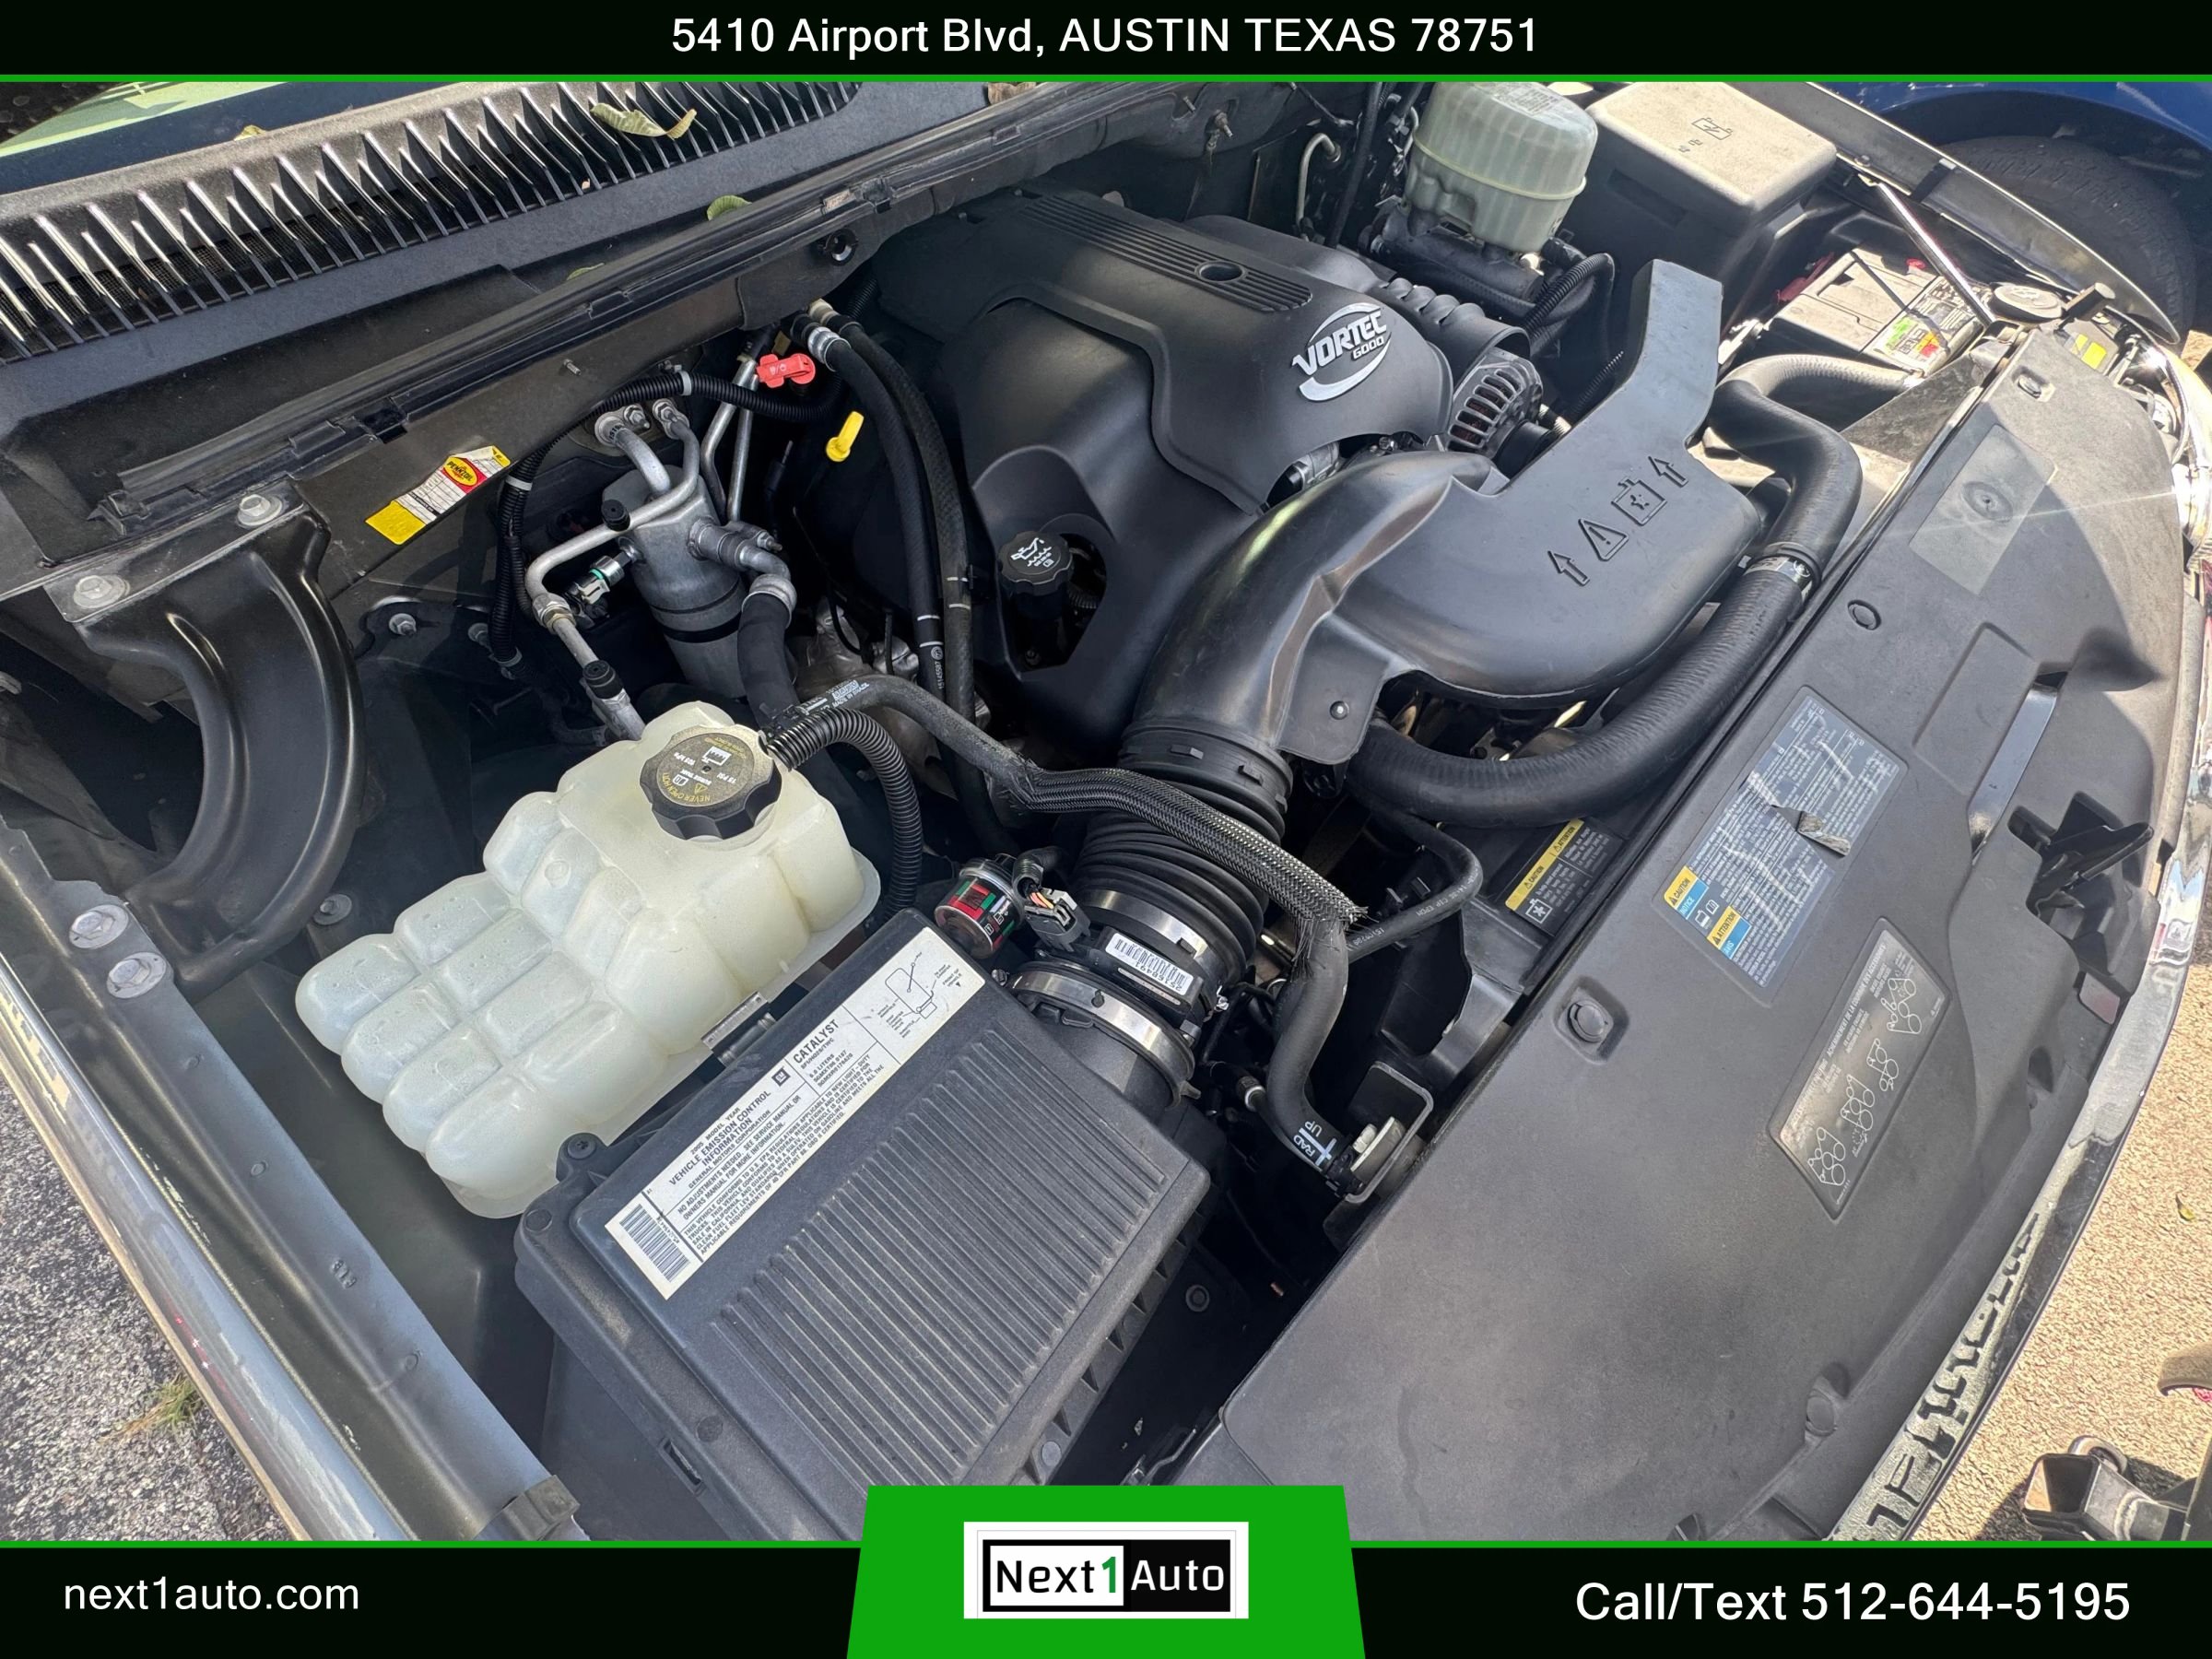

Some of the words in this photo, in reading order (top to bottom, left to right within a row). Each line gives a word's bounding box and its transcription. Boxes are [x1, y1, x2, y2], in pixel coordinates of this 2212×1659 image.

[1292, 311, 1387, 375] VORTEC
[1352, 335, 1384, 359] 6000
[447, 460, 473, 483] PENNZOIL
[1557, 825, 1576, 846] ATTENTION
[1529, 865, 1545, 883] CAUTION
[1672, 877, 1690, 899] CAUTION
[1678, 895, 1695, 915] NOTICE
[1715, 910, 1737, 938] ATTENTION
[792, 1018, 840, 1065] CATALYST
[817, 1053, 835, 1070] LITERS
[668, 1153, 701, 1185] VEHICLE
[700, 1120, 737, 1156] EMISSION
[735, 1088, 771, 1122] CONTROL
[683, 1222, 697, 1236] THIS
[695, 1203, 716, 1225] VEHICLE
[715, 1177, 743, 1206] CONFORMS
[742, 1171, 750, 1179] TO
[769, 1122, 800, 1153] REGULATIONS
[799, 1097, 826, 1124] APPLICABLE
[831, 1080, 843, 1092] NEW
[858, 1053, 870, 1065] DUTY
[688, 1164, 713, 1189] GENERAL
[712, 1143, 735, 1166] MOTORS
[735, 1109, 771, 1144] CORPORATION
[689, 1141, 703, 1155] 2005
[704, 1122, 724, 1140] MODEL
[725, 1106, 740, 1121] YEAR
[701, 1116, 752, 1166] INFORMATION
[711, 1205, 724, 1218] THIS
[722, 1186, 743, 1207] VEHICLE
[741, 1160, 769, 1188] CONFORMS
[774, 1133, 796, 1156] FEDERAL
[794, 1105, 825, 1136] REGULATIONS
[823, 1096, 835, 1107] AND
[838, 1070, 861, 1093] CERTIFIED
[859, 1061, 870, 1072] FOR
[1293, 1135, 1316, 1157] RAD
[1304, 1121, 1323, 1137] UP
[677, 1204, 688, 1214] NO
[685, 1170, 723, 1206] ADJUSTMENTS
[721, 1149, 744, 1172] NEEDED.
[743, 1139, 754, 1151] SEE
[752, 1120, 774, 1141] SERVICE
[772, 1101, 794, 1123] MANUAL
[792, 1094, 801, 1103] OR
[682, 1196, 706, 1220] OWNERS
[704, 1176, 727, 1199] MANUAL
[725, 1166, 737, 1179] FOR
[735, 1152, 751, 1169] MORE
[750, 1120, 785, 1155] INFORMATION.
[691, 1231, 706, 1245] SALE
[740, 1185, 752, 1198] AND
[750, 1162, 775, 1187] QUALIFIES
[801, 1125, 813, 1137] THIS
[812, 1108, 830, 1127] VEHICLE
[835, 1081, 857, 1104] CERTIFIED
[863, 1066, 873, 1077] THE
[696, 1232, 713, 1250] CLEAN
[712, 1220, 725, 1234] FUEL
[724, 1206, 740, 1221] FLEET
[748, 1169, 777, 1198] STANDARDS
[776, 1155, 792, 1171] WHEN
[790, 1132, 814, 1157] OPERATED
[820, 1104, 842, 1127] GASOLINE
[841, 1094, 853, 1106] AND
[851, 1080, 867, 1096] MEETS
[865, 1072, 876, 1082] ALL
[874, 1064, 884, 1074] THE
[700, 1225, 730, 1255] APPLICABLE
[728, 1189, 765, 1227] REQUIREMENTS
[787, 1154, 801, 1168] PART
